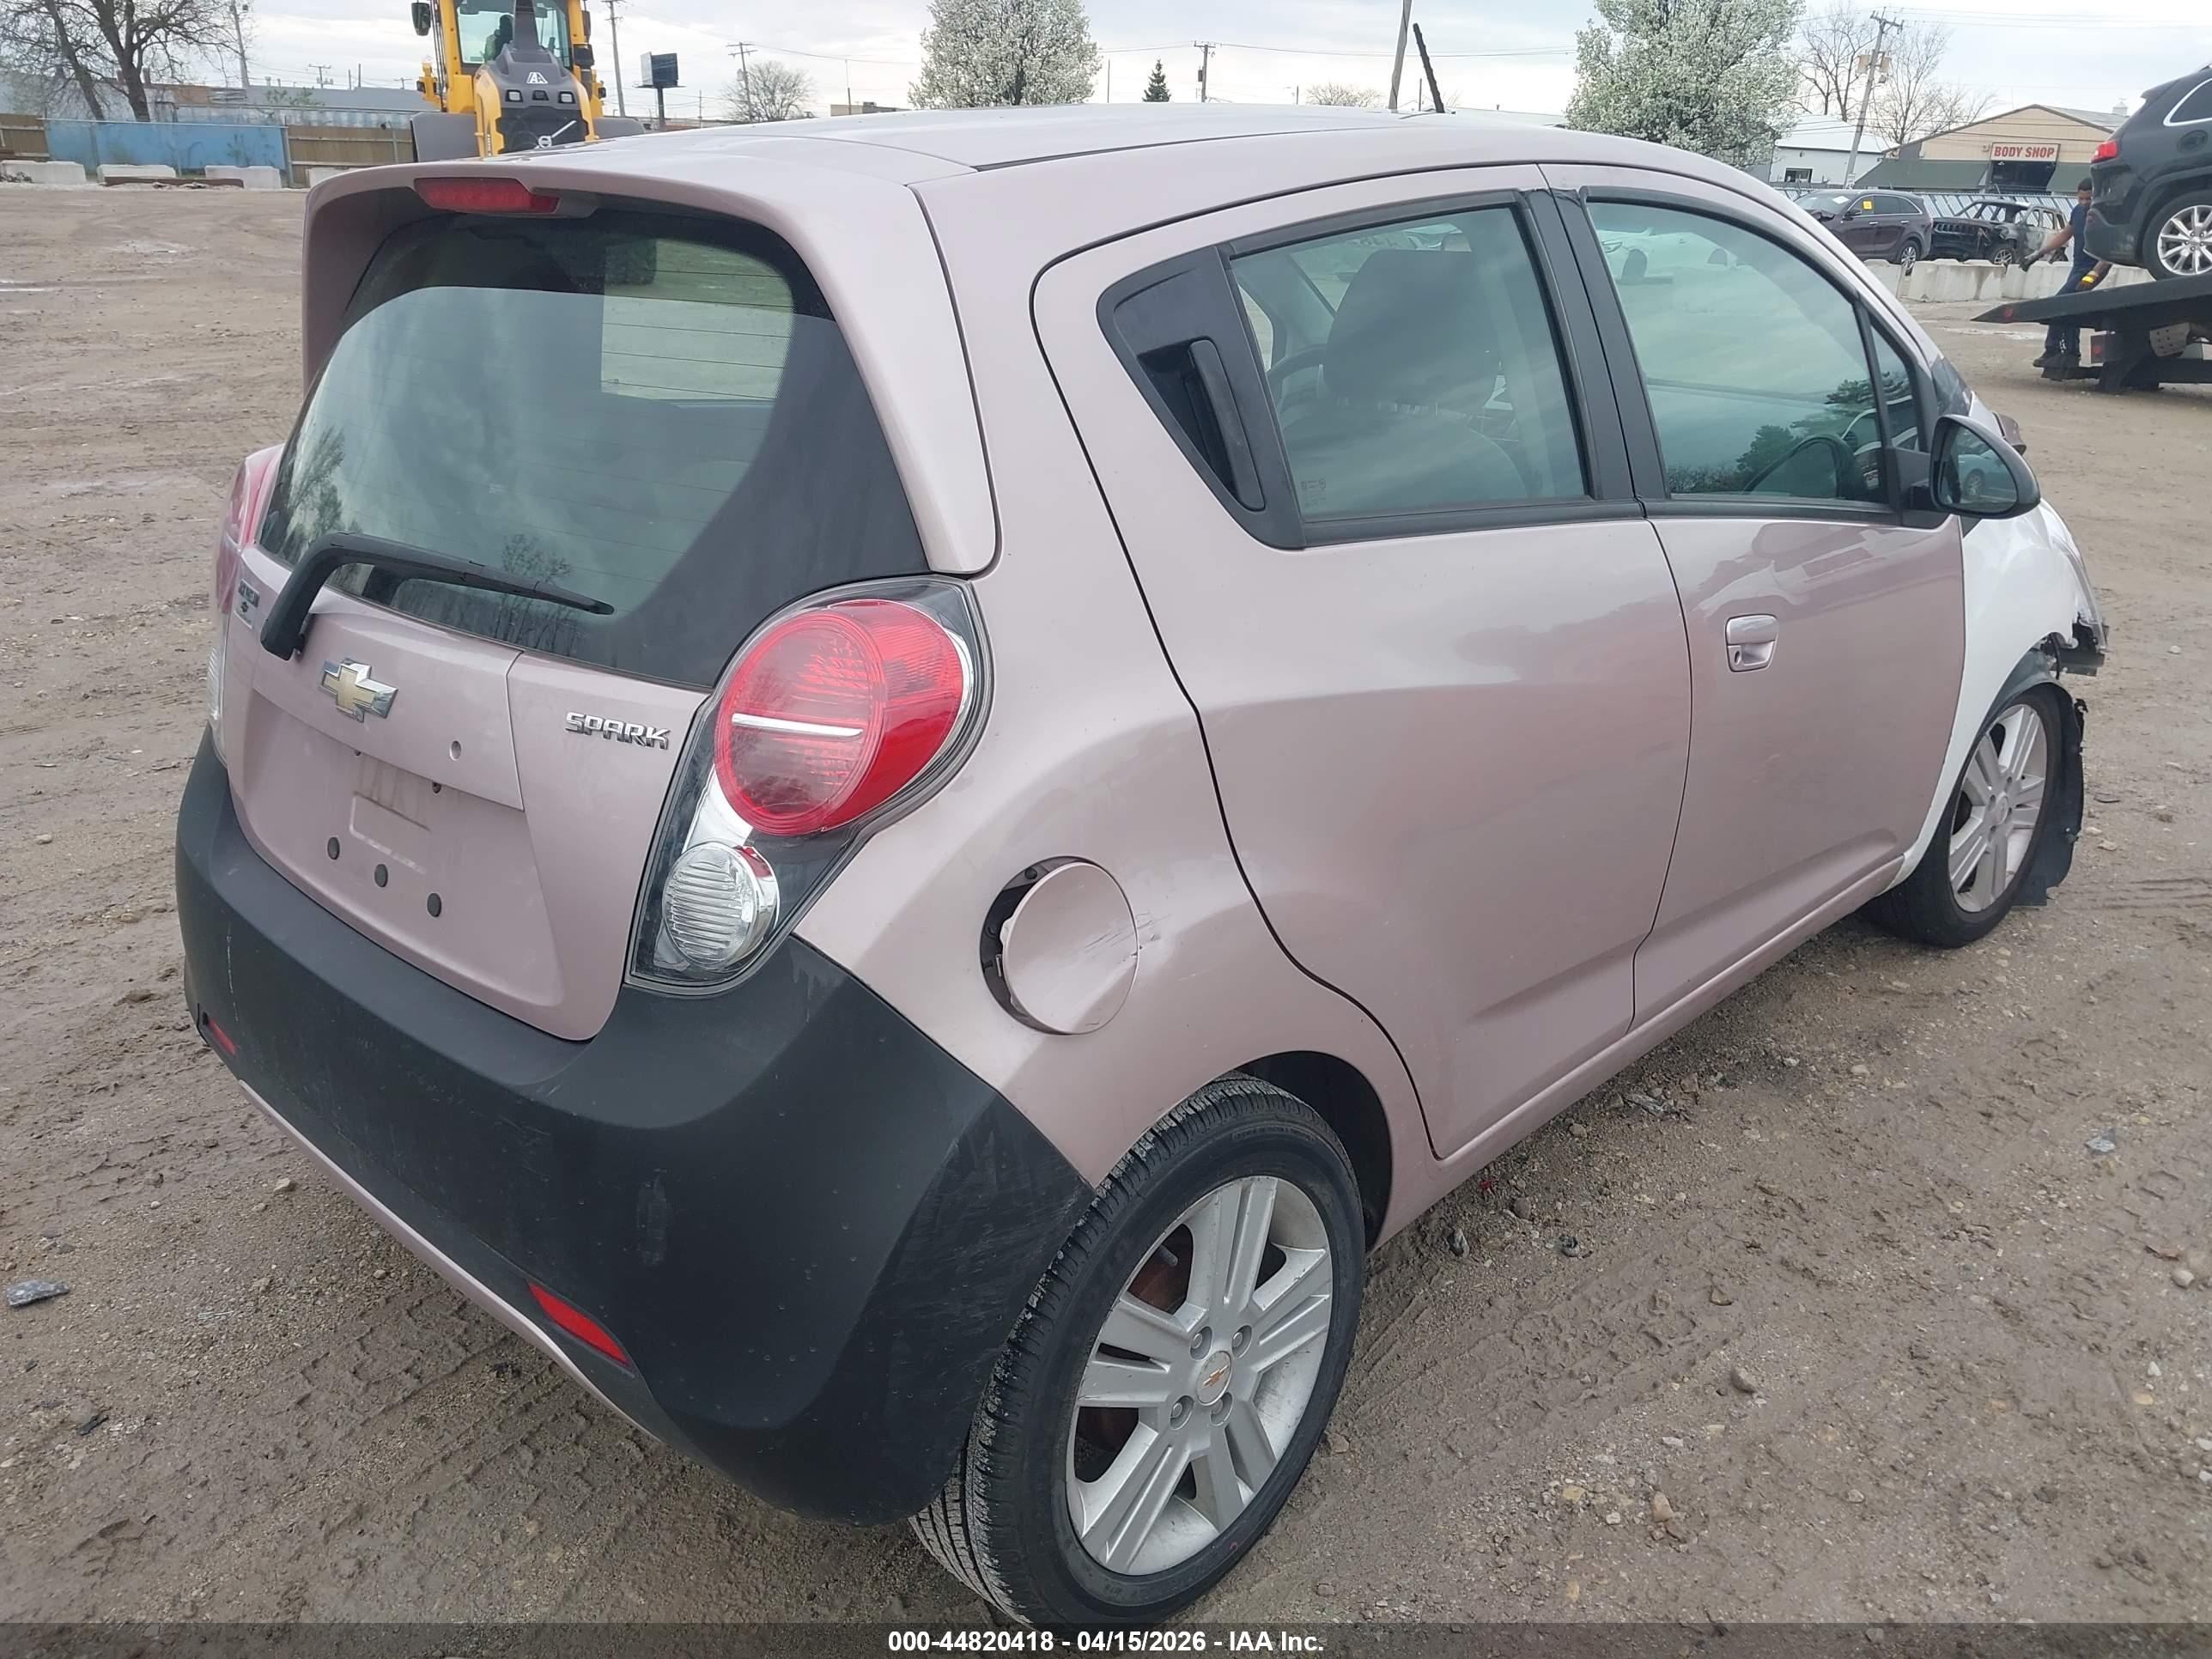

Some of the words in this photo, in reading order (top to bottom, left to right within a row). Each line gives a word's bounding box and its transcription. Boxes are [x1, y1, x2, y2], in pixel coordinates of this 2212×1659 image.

[1994, 146, 2022, 157] BODY
[2025, 147, 2055, 158] SHOP
[565, 712, 671, 750] SPARK
